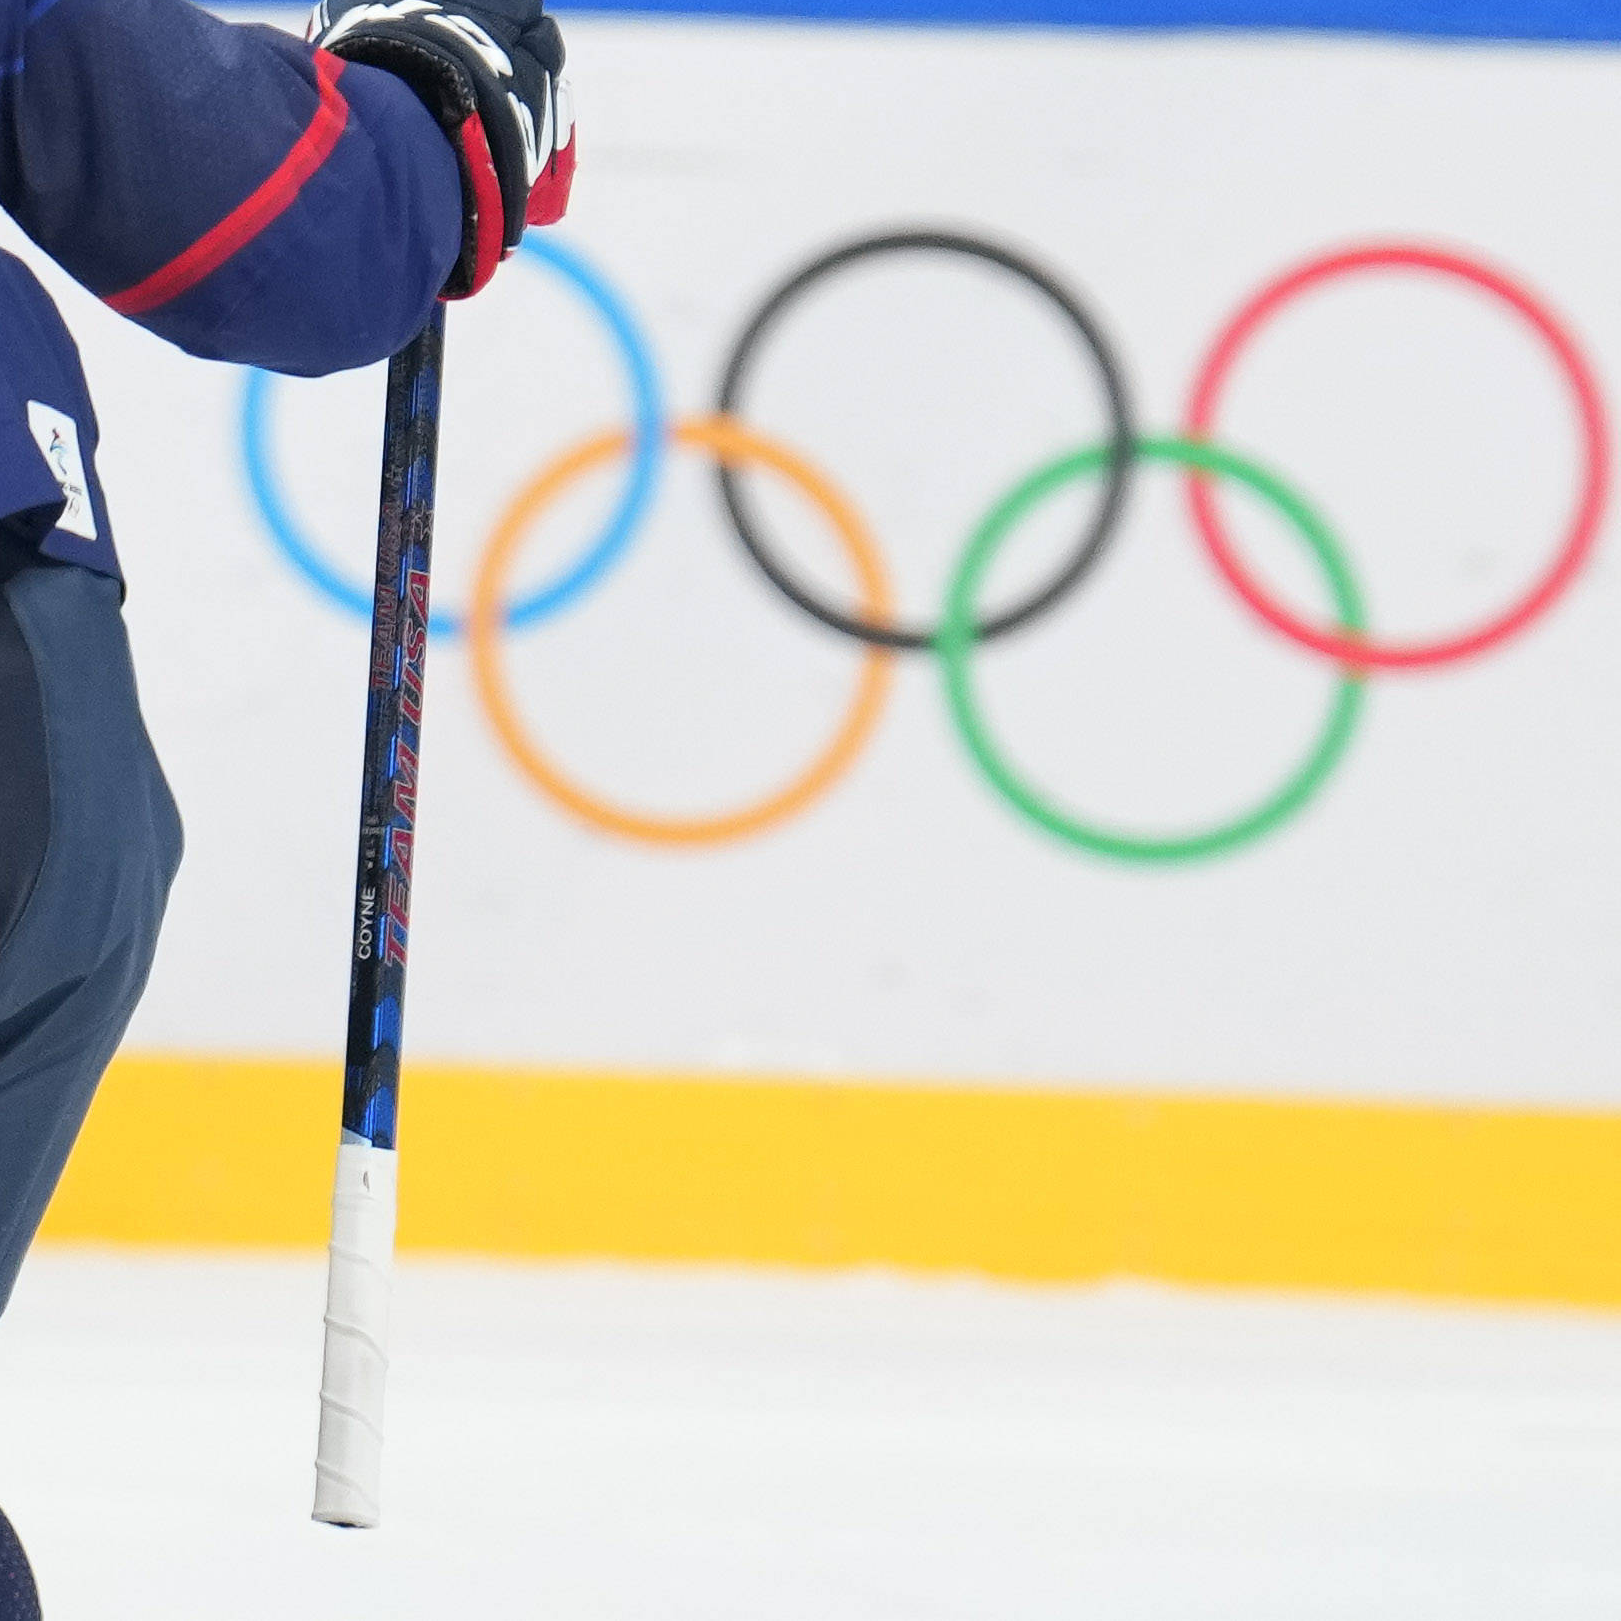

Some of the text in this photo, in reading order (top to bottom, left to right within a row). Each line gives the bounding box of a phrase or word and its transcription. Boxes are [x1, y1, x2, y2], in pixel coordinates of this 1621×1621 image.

[384, 570, 432, 968] TEAM USA
[356, 885, 376, 961] COYNE
